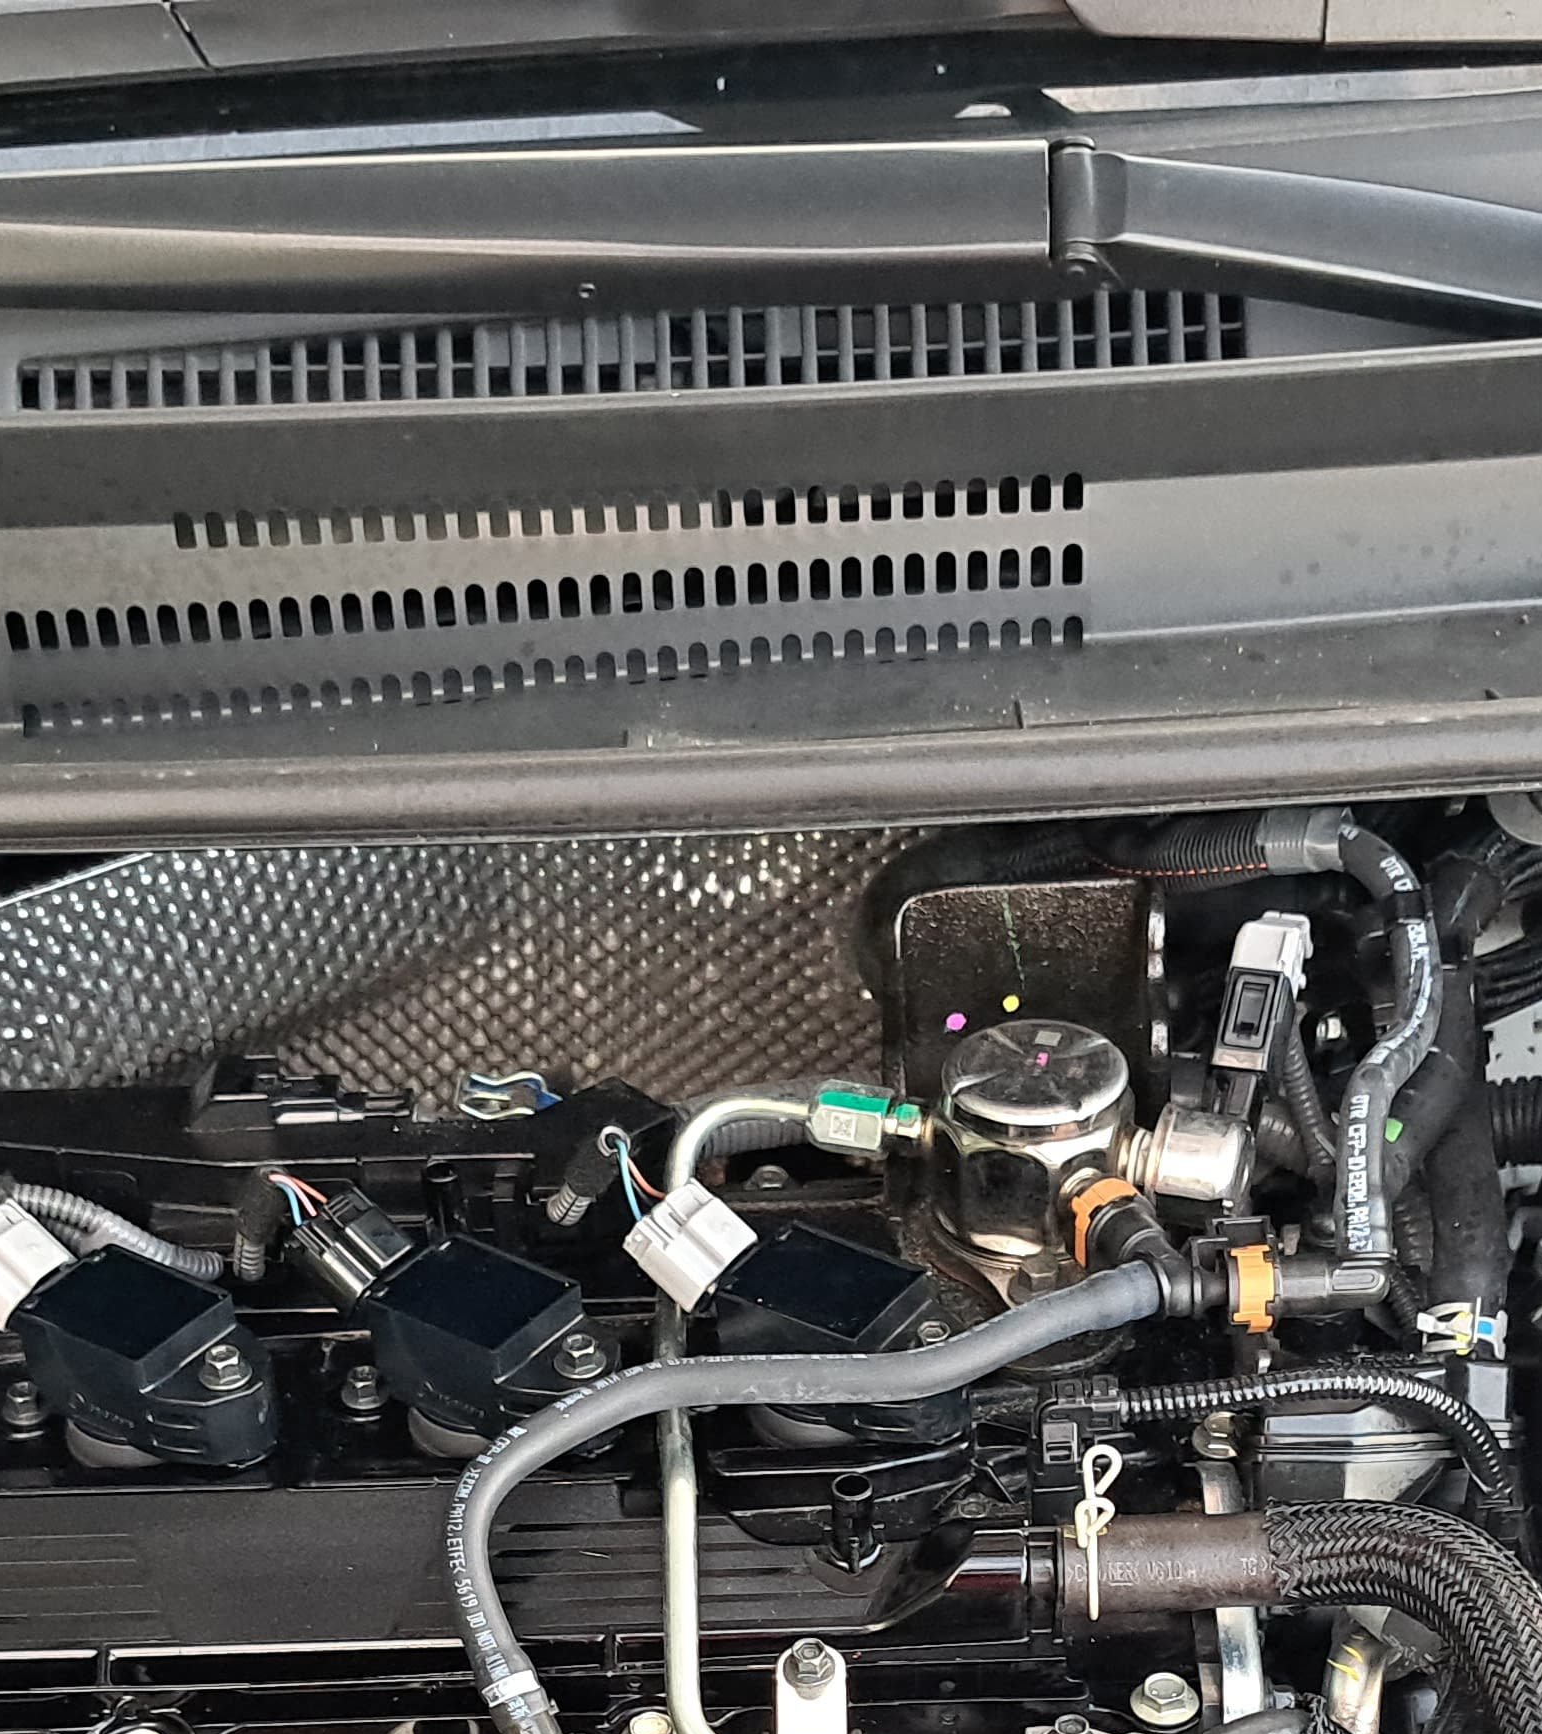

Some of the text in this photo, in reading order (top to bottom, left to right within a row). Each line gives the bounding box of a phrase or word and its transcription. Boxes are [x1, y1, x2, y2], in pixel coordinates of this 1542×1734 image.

[454, 1578, 479, 1608] 5619
[465, 1610, 488, 1629] DO
[474, 1629, 499, 1653] NOT
